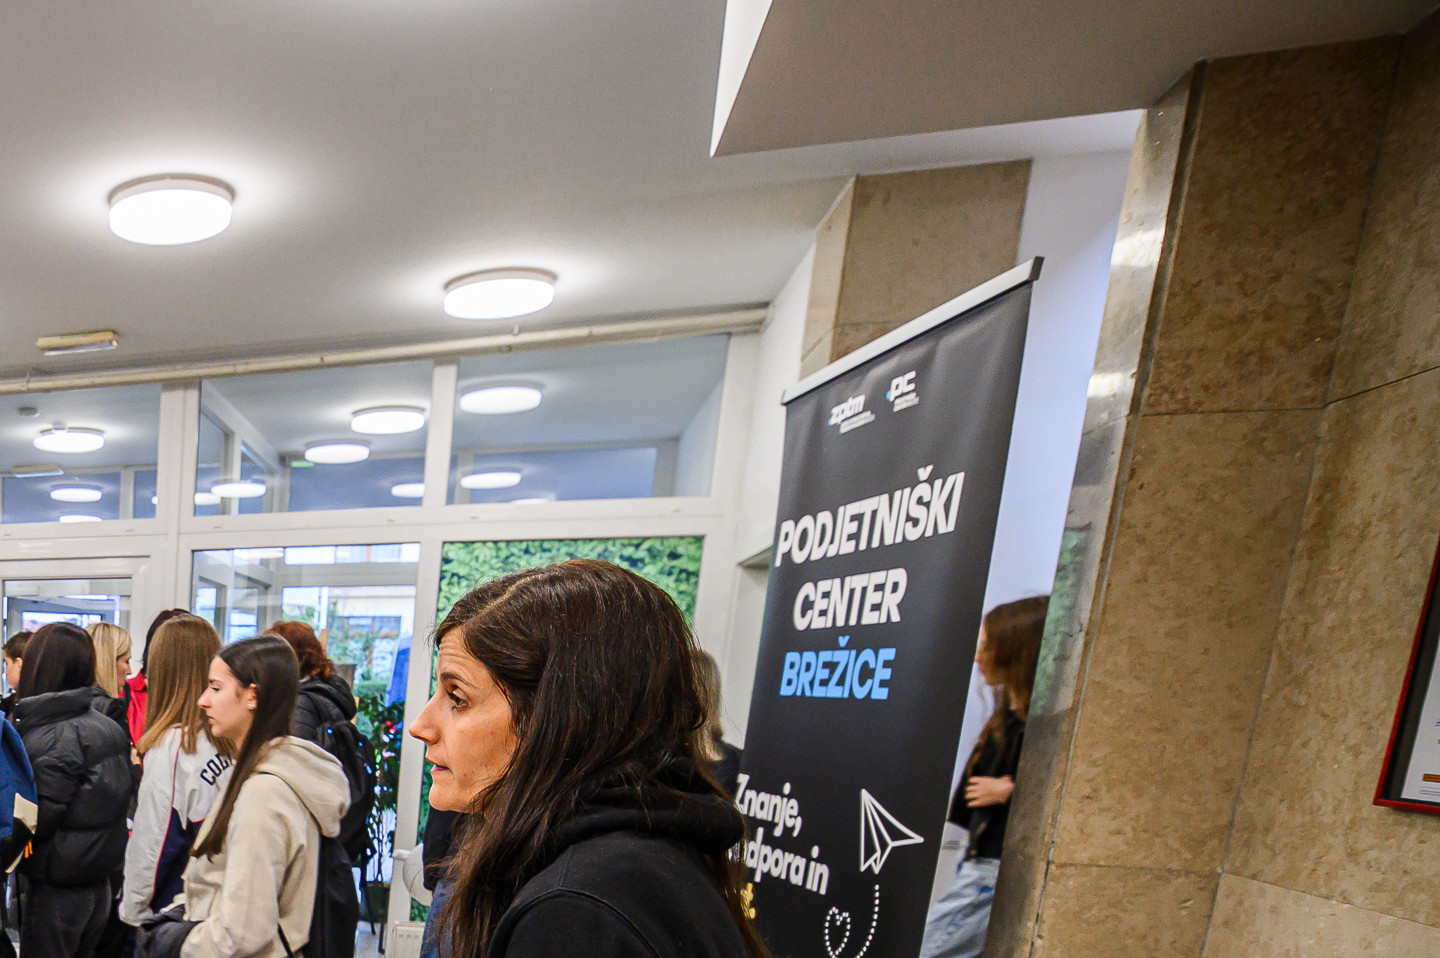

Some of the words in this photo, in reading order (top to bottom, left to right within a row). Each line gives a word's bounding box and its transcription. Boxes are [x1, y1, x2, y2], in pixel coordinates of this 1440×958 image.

[774, 465, 965, 567] PODJETNIŠKI
[793, 568, 908, 631] CENTER
[779, 635, 897, 700] BREŽICE
[736, 773, 802, 837] Znanje,
[738, 827, 807, 887] dpora
[805, 845, 830, 895] in
